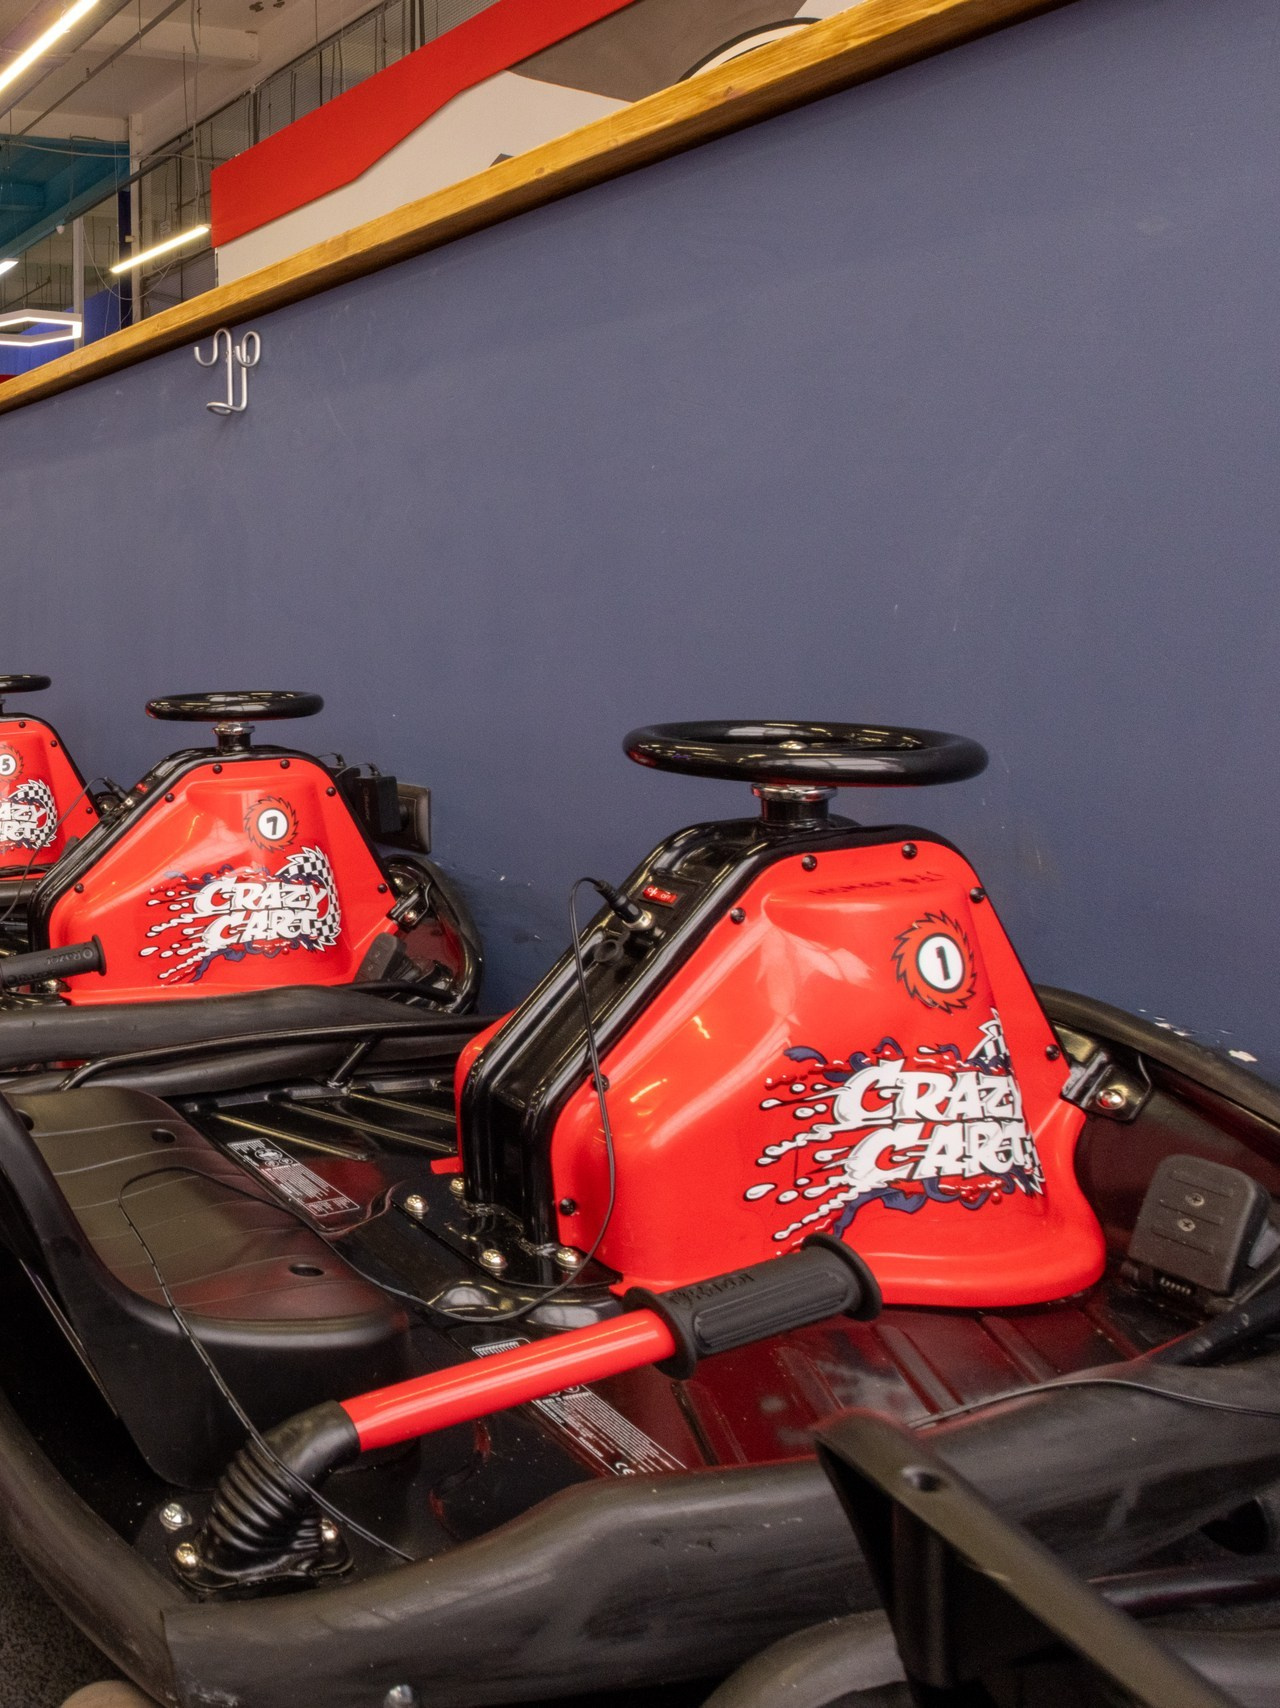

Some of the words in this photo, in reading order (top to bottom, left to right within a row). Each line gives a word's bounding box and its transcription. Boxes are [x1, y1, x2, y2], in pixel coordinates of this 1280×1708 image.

[1, 758, 11, 772] 5
[266, 815, 279, 836] 7
[193, 877, 328, 915] CRAZY
[202, 909, 321, 947] CART
[935, 945, 951, 981] 1
[842, 1120, 1028, 1187] CART
